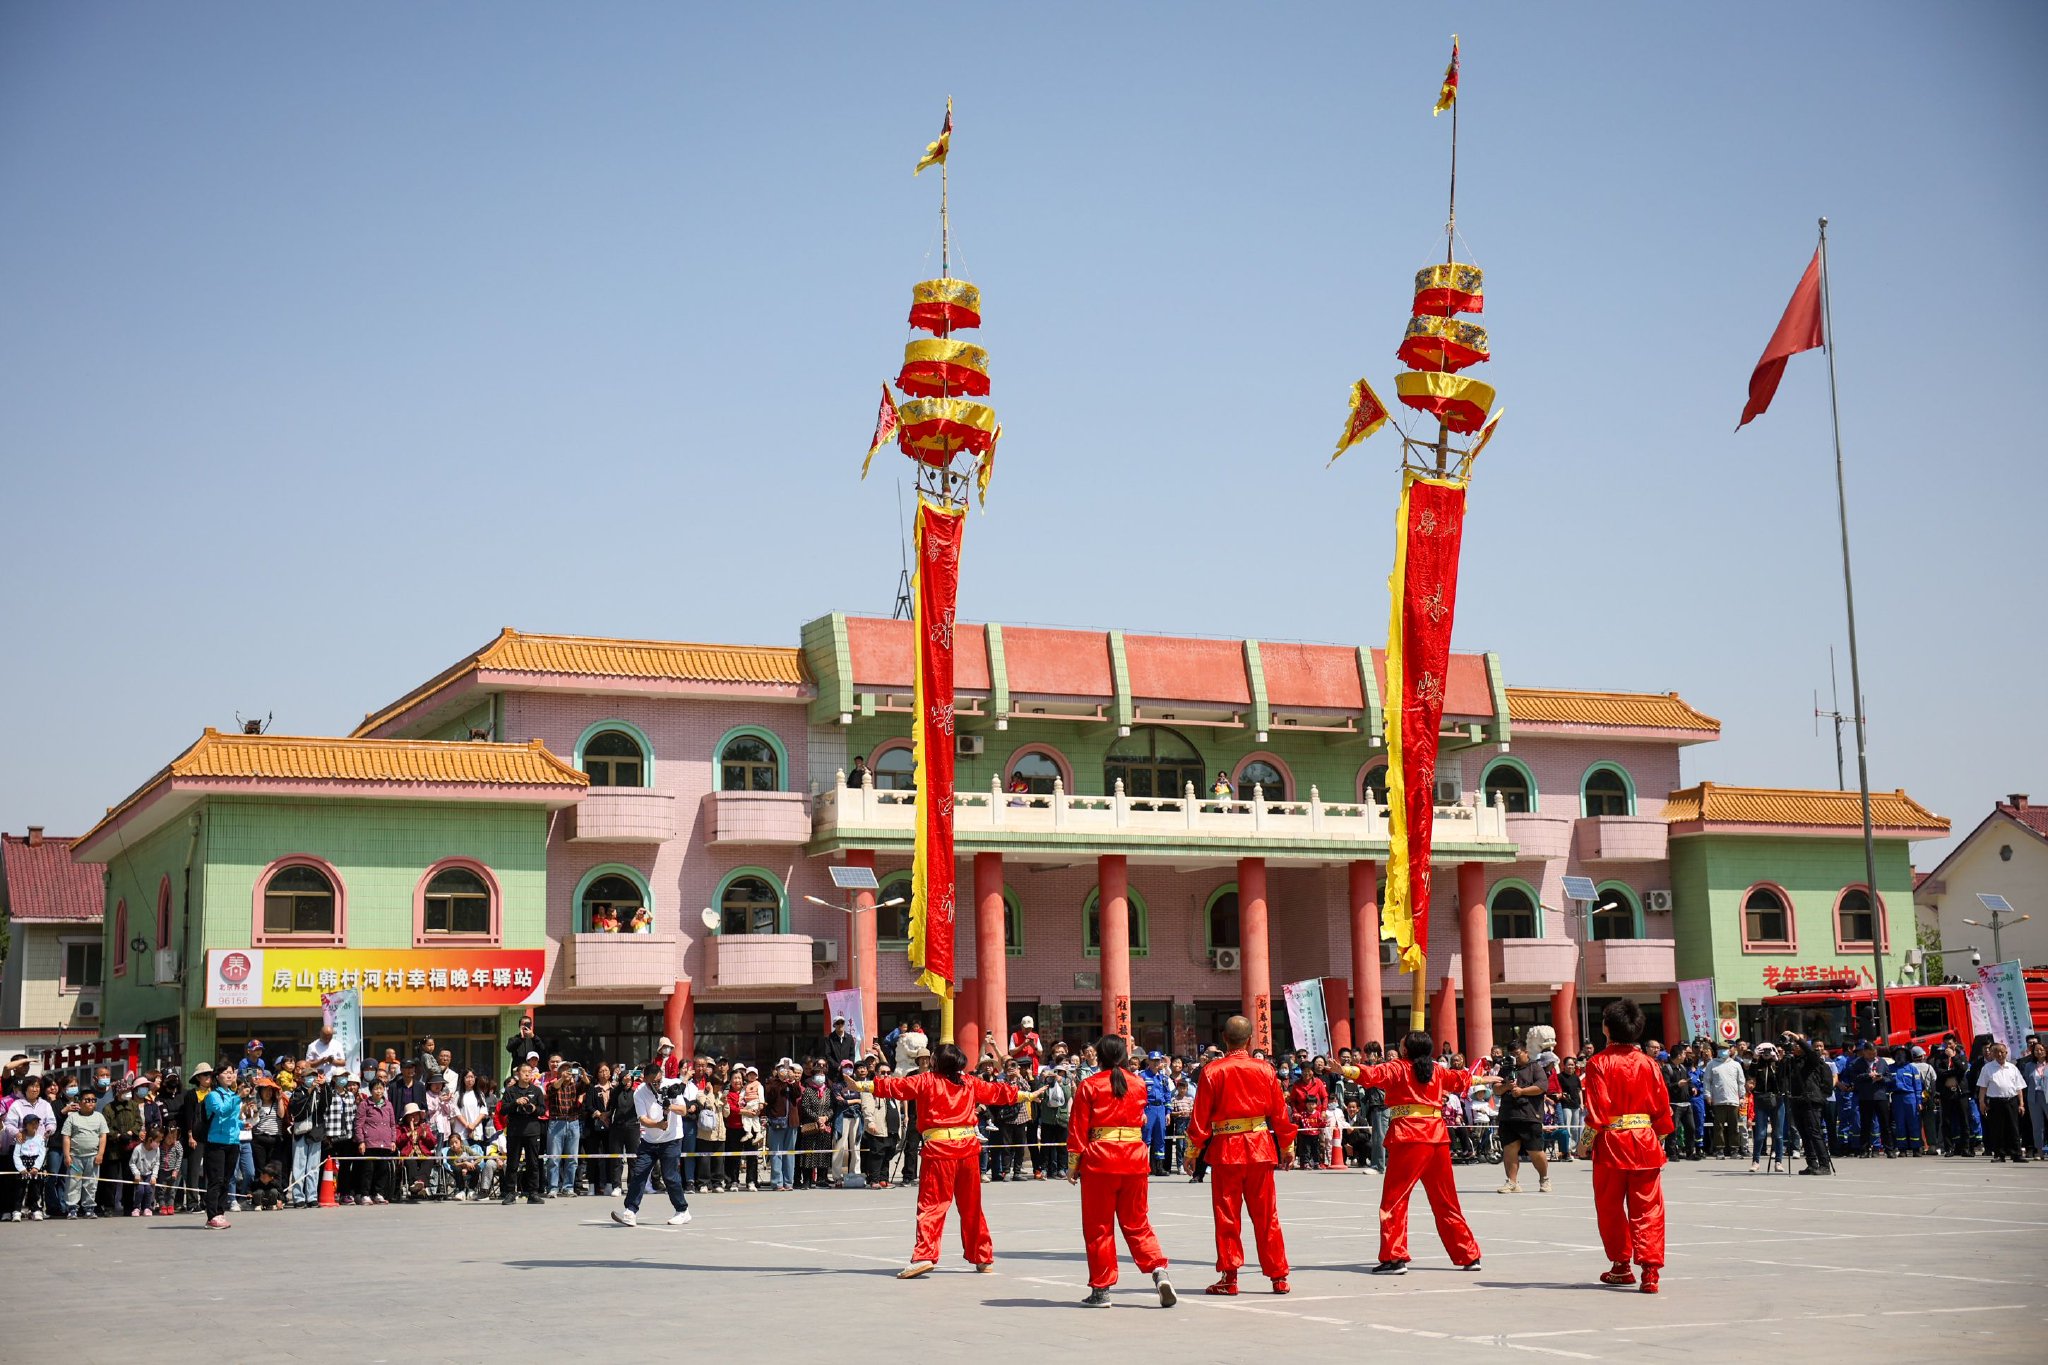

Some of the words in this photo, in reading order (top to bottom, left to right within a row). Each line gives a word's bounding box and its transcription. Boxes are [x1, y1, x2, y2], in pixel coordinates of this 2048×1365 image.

[273, 968, 533, 988] 房山韩村河村幸福晚年驿站
[219, 983, 248, 991] 北京养老
[219, 997, 248, 1005] 96156
